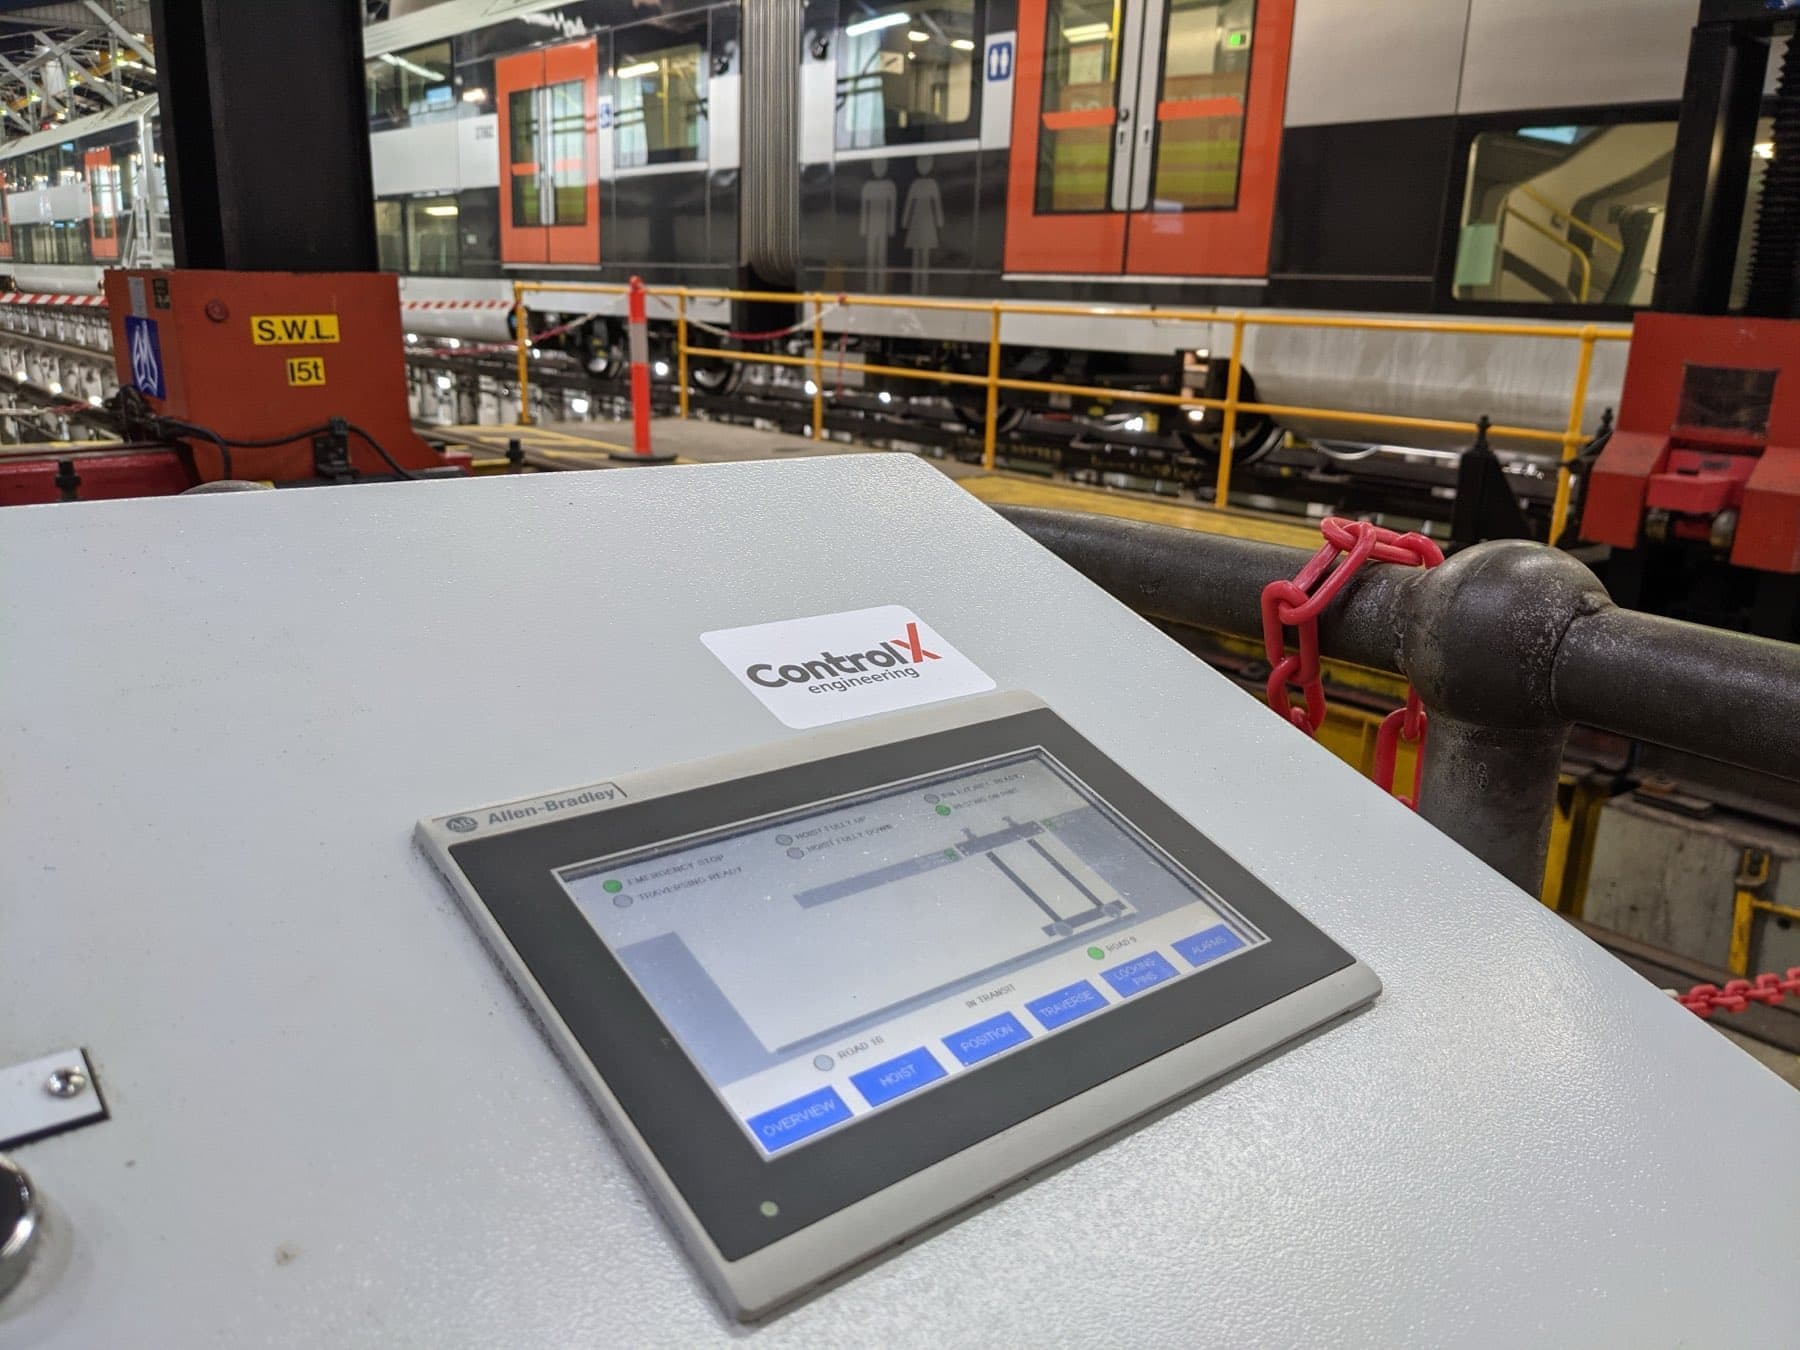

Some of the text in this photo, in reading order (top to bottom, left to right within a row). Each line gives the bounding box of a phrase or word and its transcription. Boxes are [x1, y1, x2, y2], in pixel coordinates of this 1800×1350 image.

[257, 319, 335, 341] S.W.L.
[289, 361, 323, 382] 15t
[746, 622, 942, 688] ControlX
[808, 667, 920, 694] engineering
[488, 788, 615, 825] Allen-Bradley
[627, 854, 725, 885] EMERGENCY STOP
[639, 866, 743, 901] TRAVERSING READY
[965, 984, 1016, 1009] IN TRANSIT
[1039, 989, 1096, 1017] TRAVERSE
[838, 1041, 869, 1059] ROAD
[959, 1024, 1014, 1053] POSITION
[879, 1064, 918, 1087] HOIST
[763, 1099, 836, 1136] OVERVIEW
